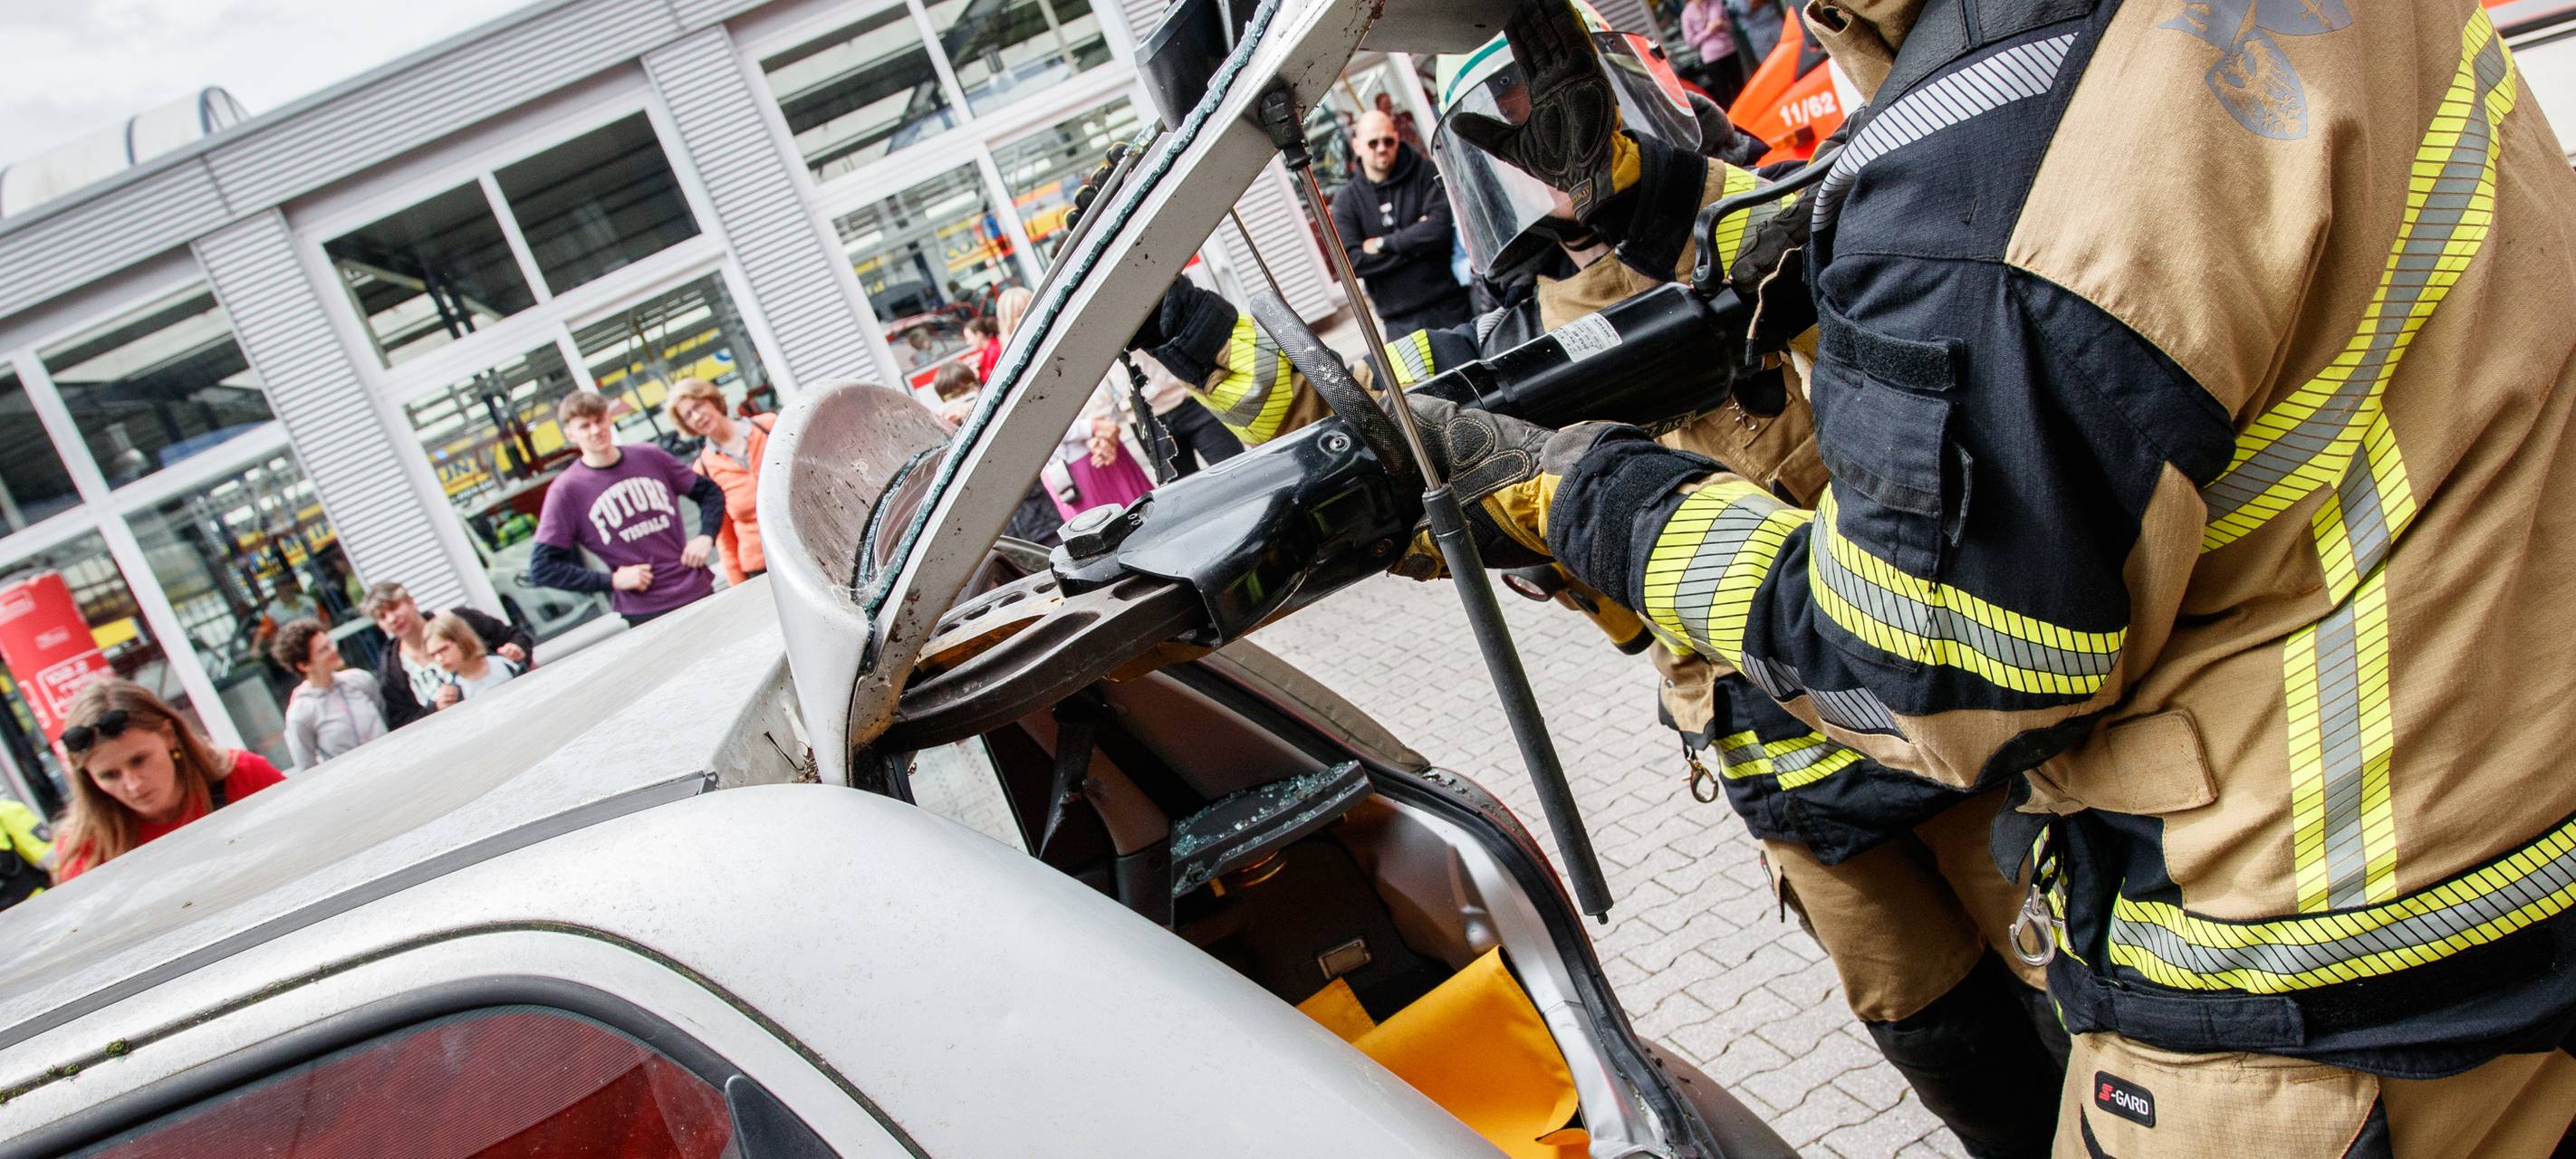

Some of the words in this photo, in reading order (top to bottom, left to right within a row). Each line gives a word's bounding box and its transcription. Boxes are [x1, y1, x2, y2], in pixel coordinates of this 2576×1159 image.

[1780, 91, 1838, 127] 11/62
[589, 476, 676, 545] FUTURE
[618, 514, 670, 543] VISUALS
[2098, 1083, 2149, 1116] S-GARD
